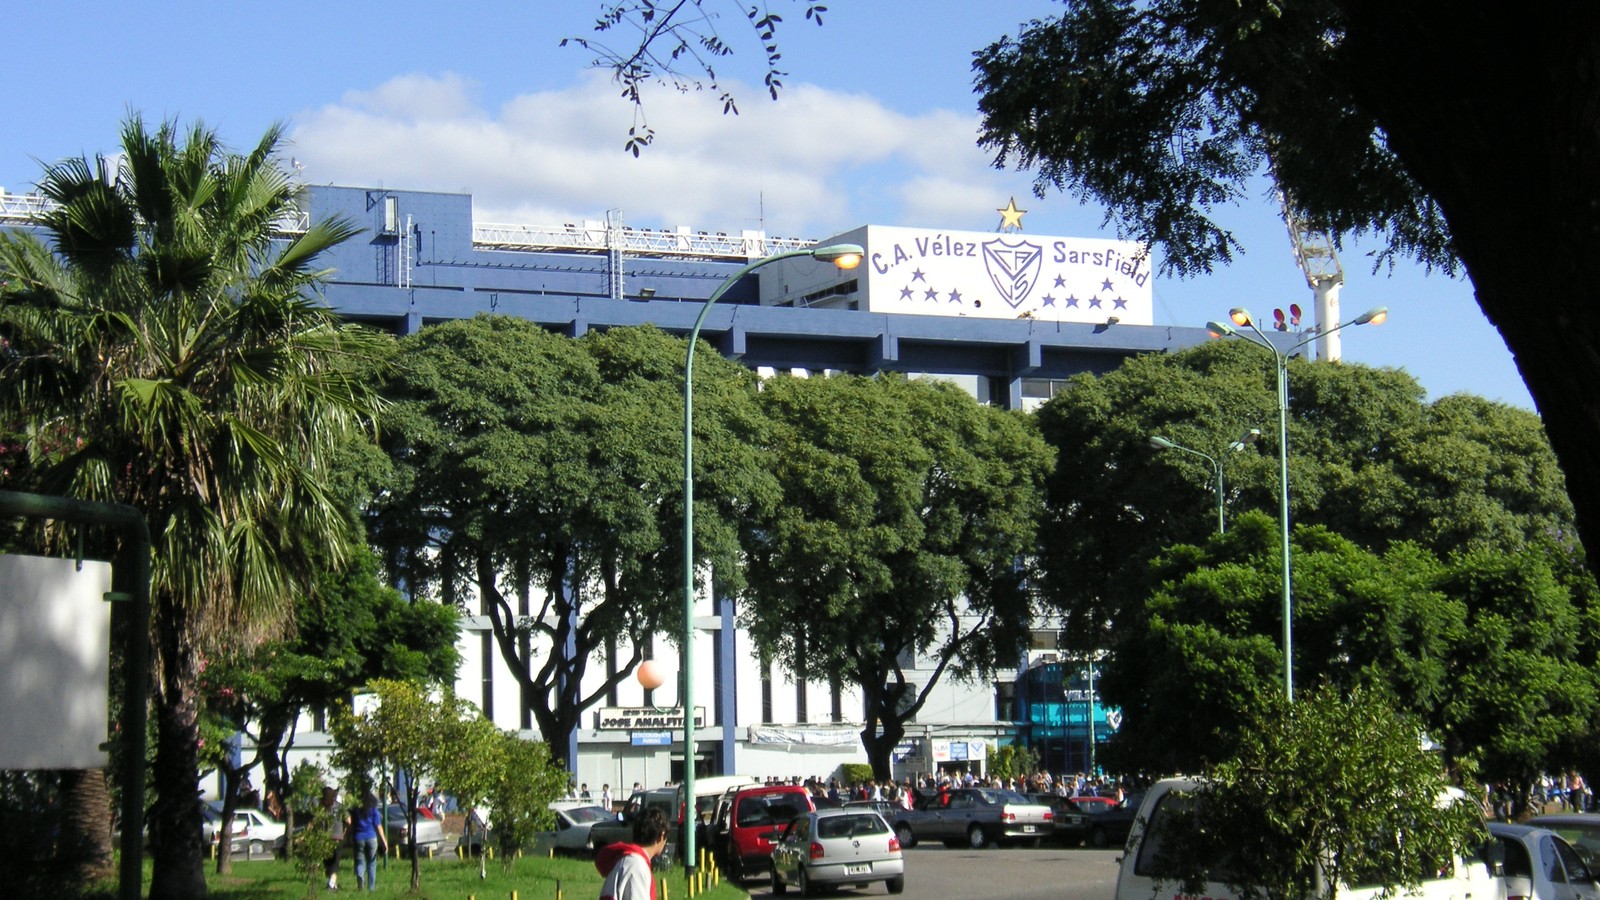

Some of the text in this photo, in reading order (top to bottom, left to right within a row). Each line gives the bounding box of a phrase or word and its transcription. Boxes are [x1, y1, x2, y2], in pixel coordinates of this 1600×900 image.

[871, 234, 1150, 288] C.A. Vélez Sarsfield
[601, 717, 632, 728] JOSE
